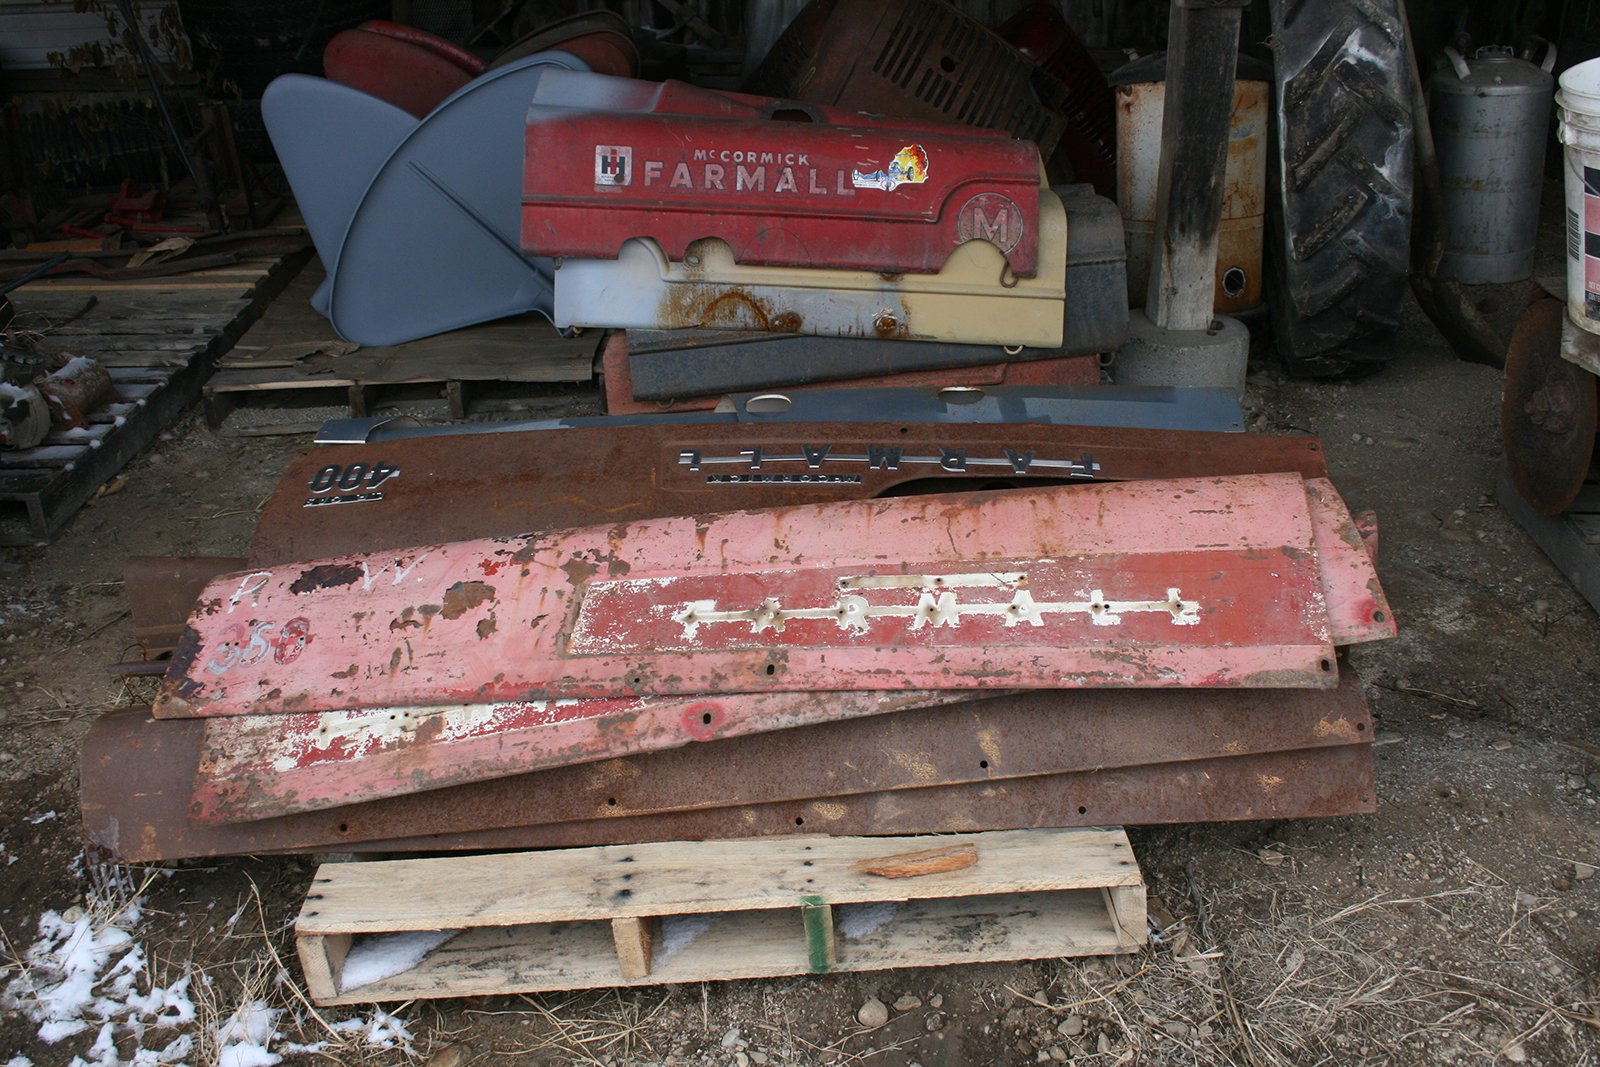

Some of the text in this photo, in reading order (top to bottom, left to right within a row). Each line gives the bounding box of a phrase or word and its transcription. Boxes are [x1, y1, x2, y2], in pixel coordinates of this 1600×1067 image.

[643, 160, 856, 197] FARMALL
[973, 207, 1008, 243] M
[307, 460, 401, 494] 400
[678, 444, 1101, 478] FARMALL
[673, 588, 1200, 640] FARMALL
